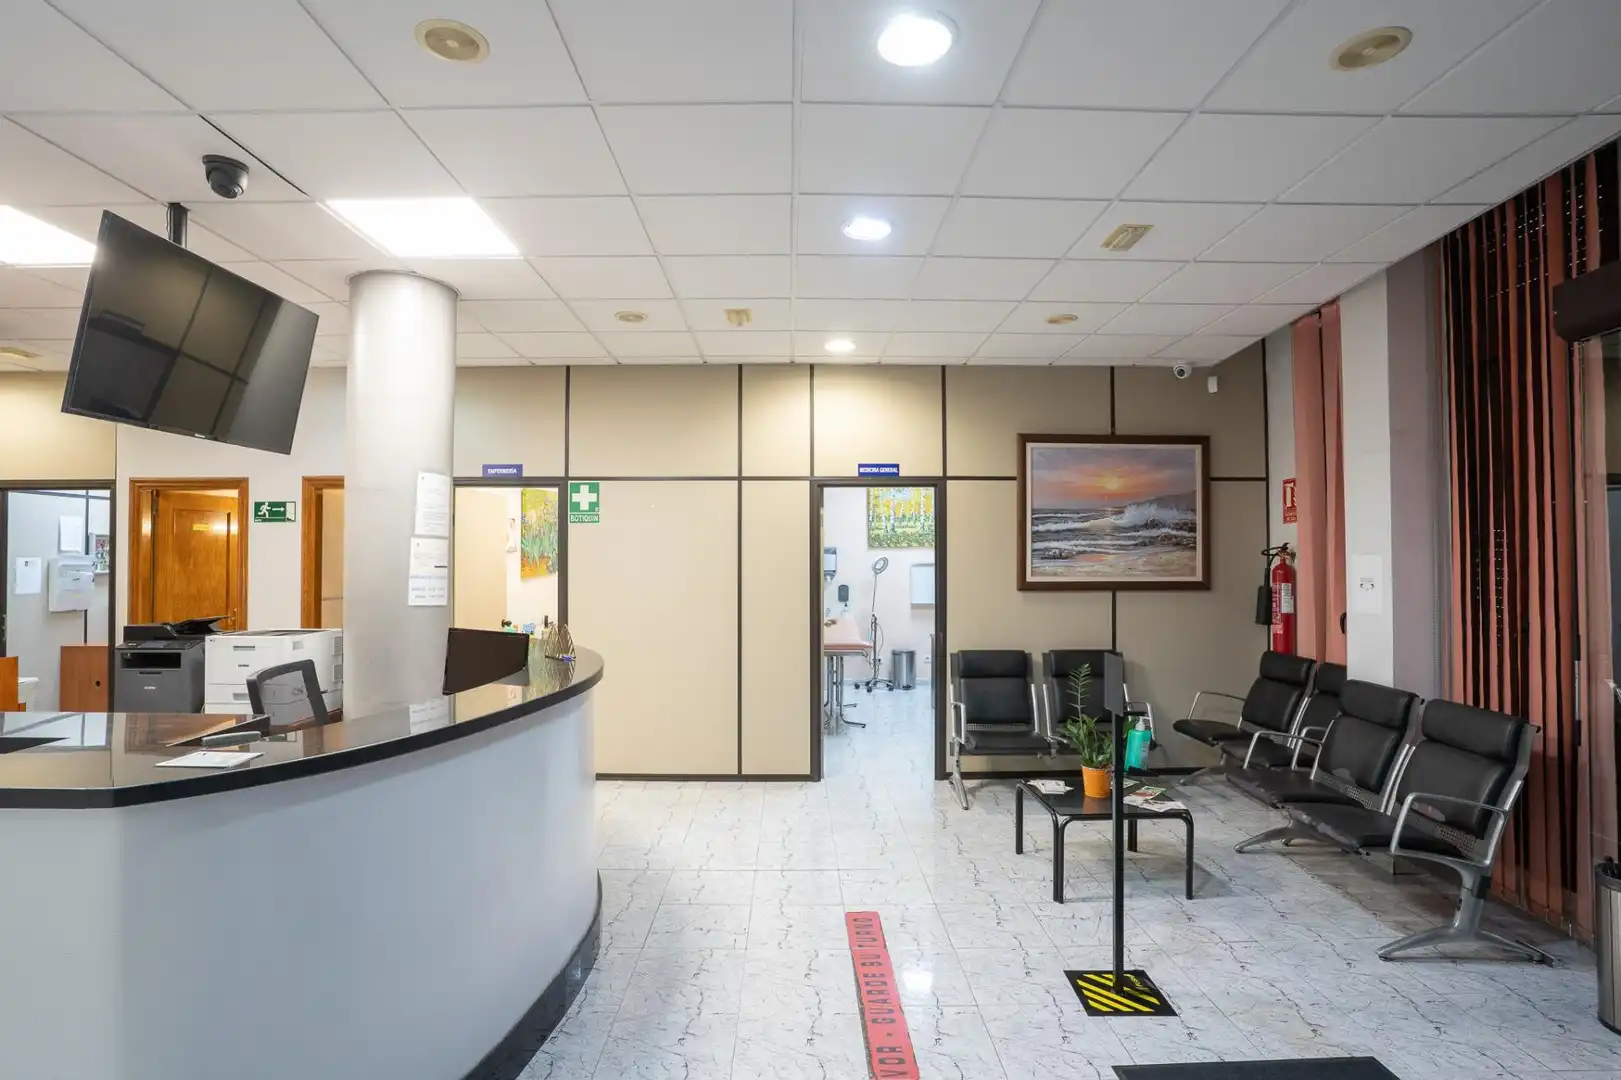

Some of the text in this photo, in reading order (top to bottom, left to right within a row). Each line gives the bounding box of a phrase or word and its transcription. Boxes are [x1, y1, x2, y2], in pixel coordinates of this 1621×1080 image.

[853, 918, 878, 947] TURNO
[860, 954, 882, 966] SU
[863, 974, 895, 1024] GUARDE
